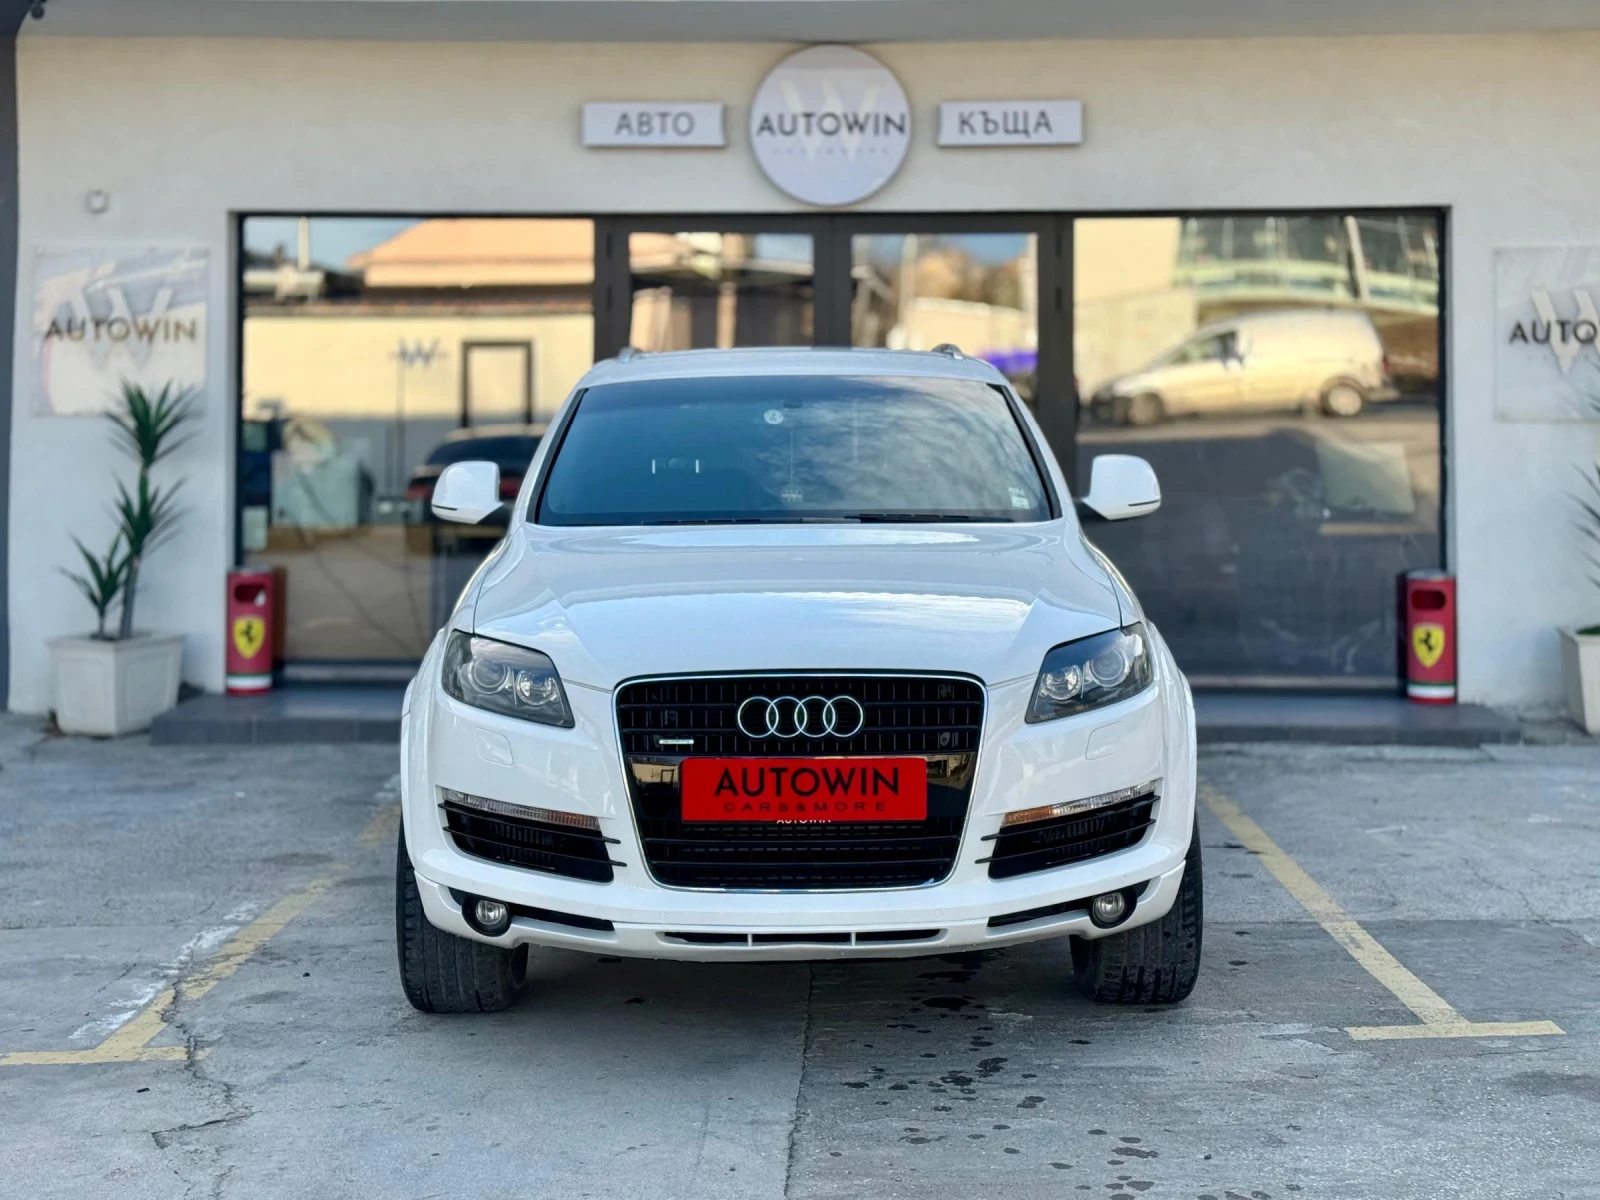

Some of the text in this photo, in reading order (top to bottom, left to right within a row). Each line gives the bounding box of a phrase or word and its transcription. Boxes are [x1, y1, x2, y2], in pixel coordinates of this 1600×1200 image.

[614, 111, 696, 137] АВТО
[756, 112, 906, 137] AUTOWIN
[958, 110, 1054, 140] КЪЩА
[44, 316, 197, 343] AUTOWIN
[714, 766, 899, 797] AUTOWIN
[723, 801, 887, 813] CARS&MORE
